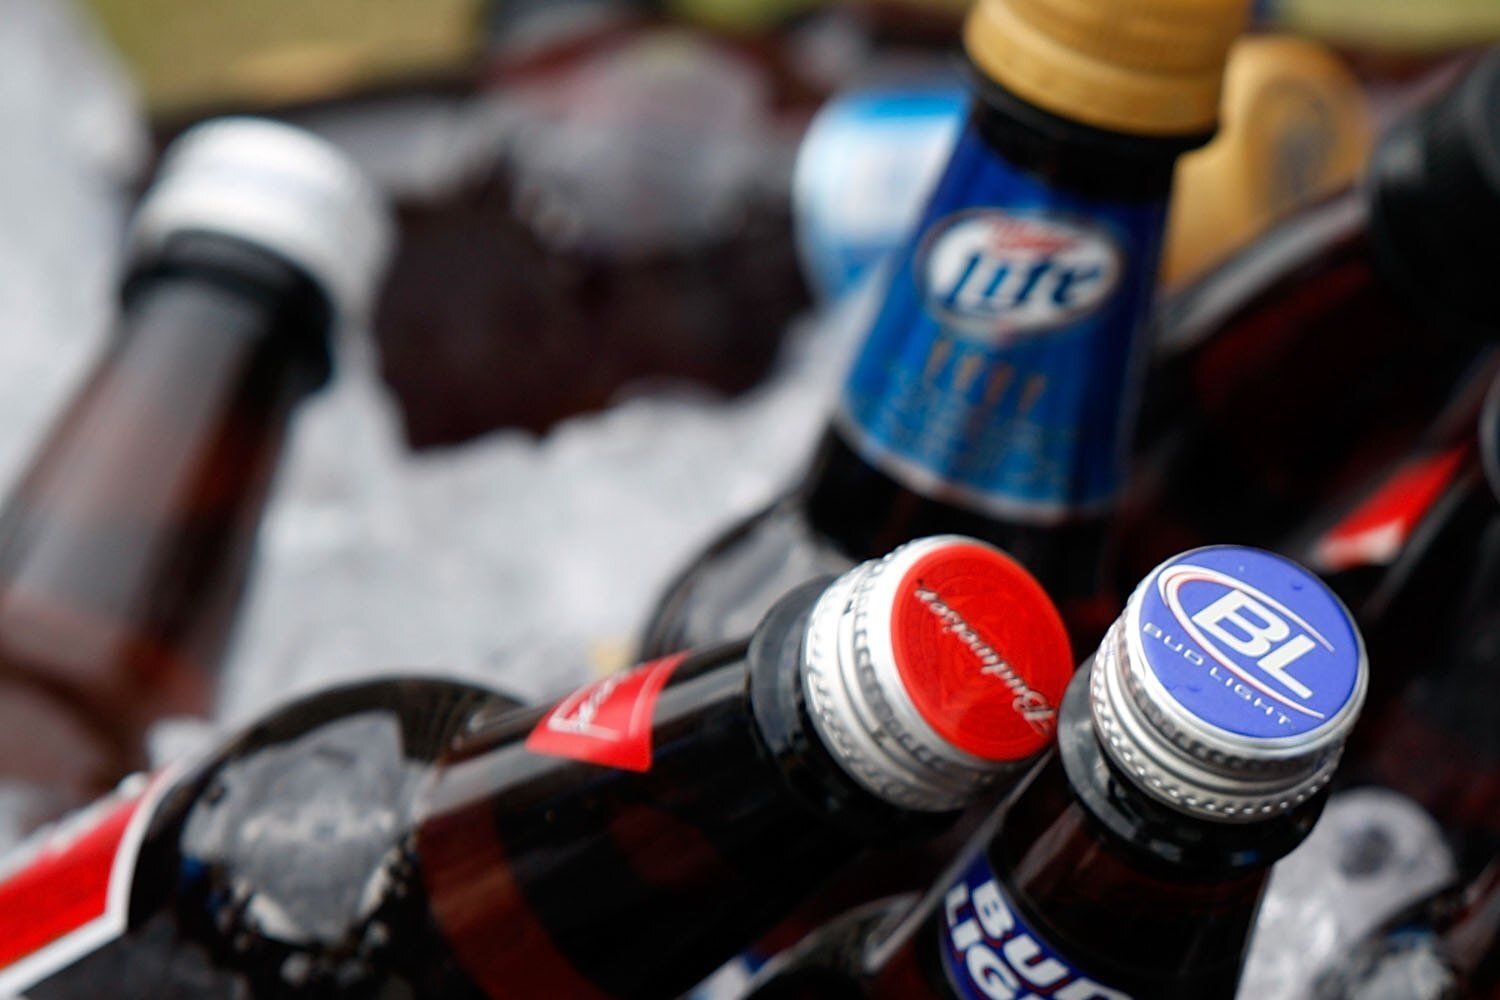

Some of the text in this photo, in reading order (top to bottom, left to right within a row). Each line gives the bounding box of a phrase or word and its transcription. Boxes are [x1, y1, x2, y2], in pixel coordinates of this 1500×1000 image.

[914, 586, 1056, 737] Budweiser
[1142, 621, 1293, 727] BUD LIGHT
[1191, 588, 1317, 700] BL
